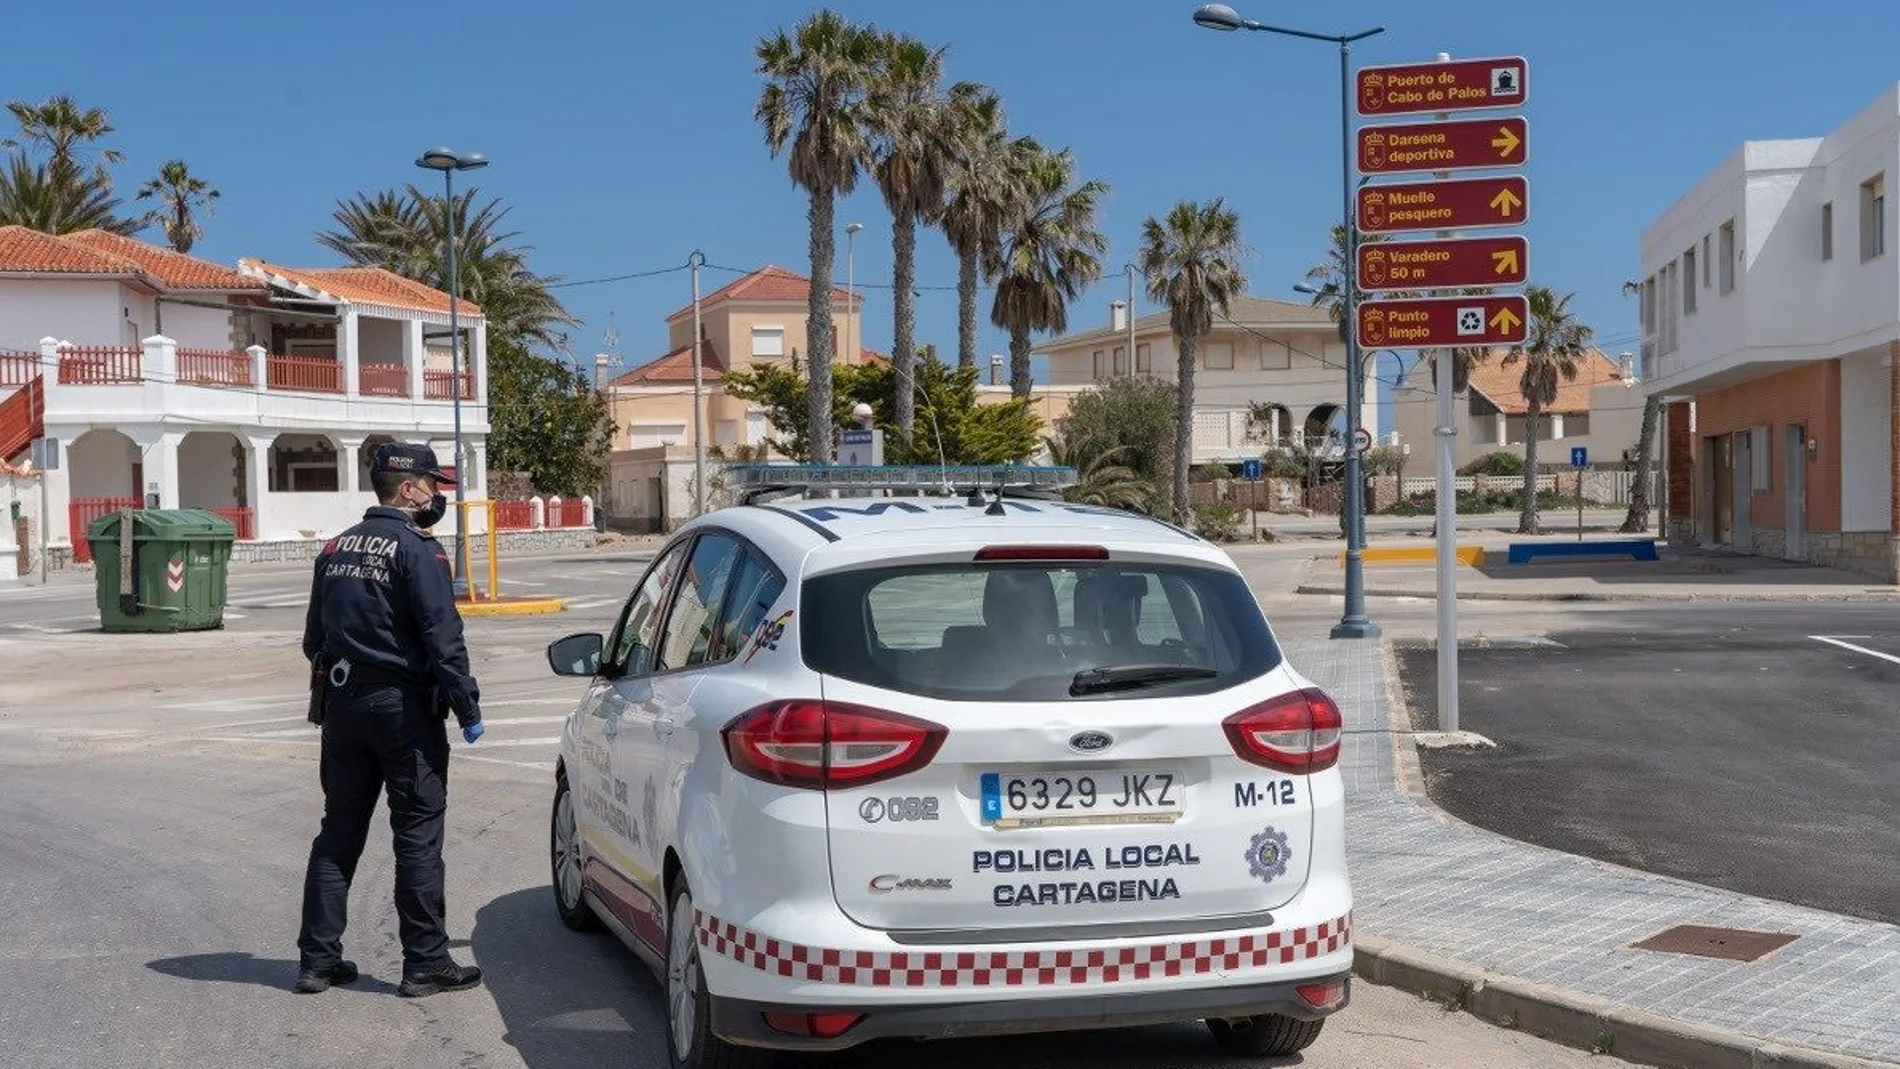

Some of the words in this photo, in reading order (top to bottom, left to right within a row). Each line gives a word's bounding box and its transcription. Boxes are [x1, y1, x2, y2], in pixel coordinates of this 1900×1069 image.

[1387, 74, 1434, 87] Puerto
[1438, 72, 1455, 84] de
[1387, 91, 1423, 104] Cabo
[1427, 89, 1444, 101] de
[1448, 86, 1487, 100] Palos
[1388, 132, 1446, 147] Darsena
[1389, 148, 1455, 164] deportiva
[1388, 192, 1436, 205] Muelle
[1389, 208, 1452, 223] pesquero
[1389, 250, 1450, 264] Varadero
[1390, 269, 1408, 279] 50
[1413, 270, 1425, 278] m
[1389, 310, 1429, 322] Punto
[1389, 326, 1430, 340] limpio
[335, 535, 398, 558] POLICIA
[363, 555, 388, 569] LOCAL
[325, 563, 389, 583] CARTAGENA
[1007, 776, 1096, 811] 6329
[1113, 774, 1175, 808] JKZ
[1235, 780, 1295, 807] M-12
[888, 797, 939, 821] 092
[973, 848, 1095, 873] POLICIA
[1105, 843, 1200, 869] LOCAL
[993, 877, 1180, 907] CARTAGENA
